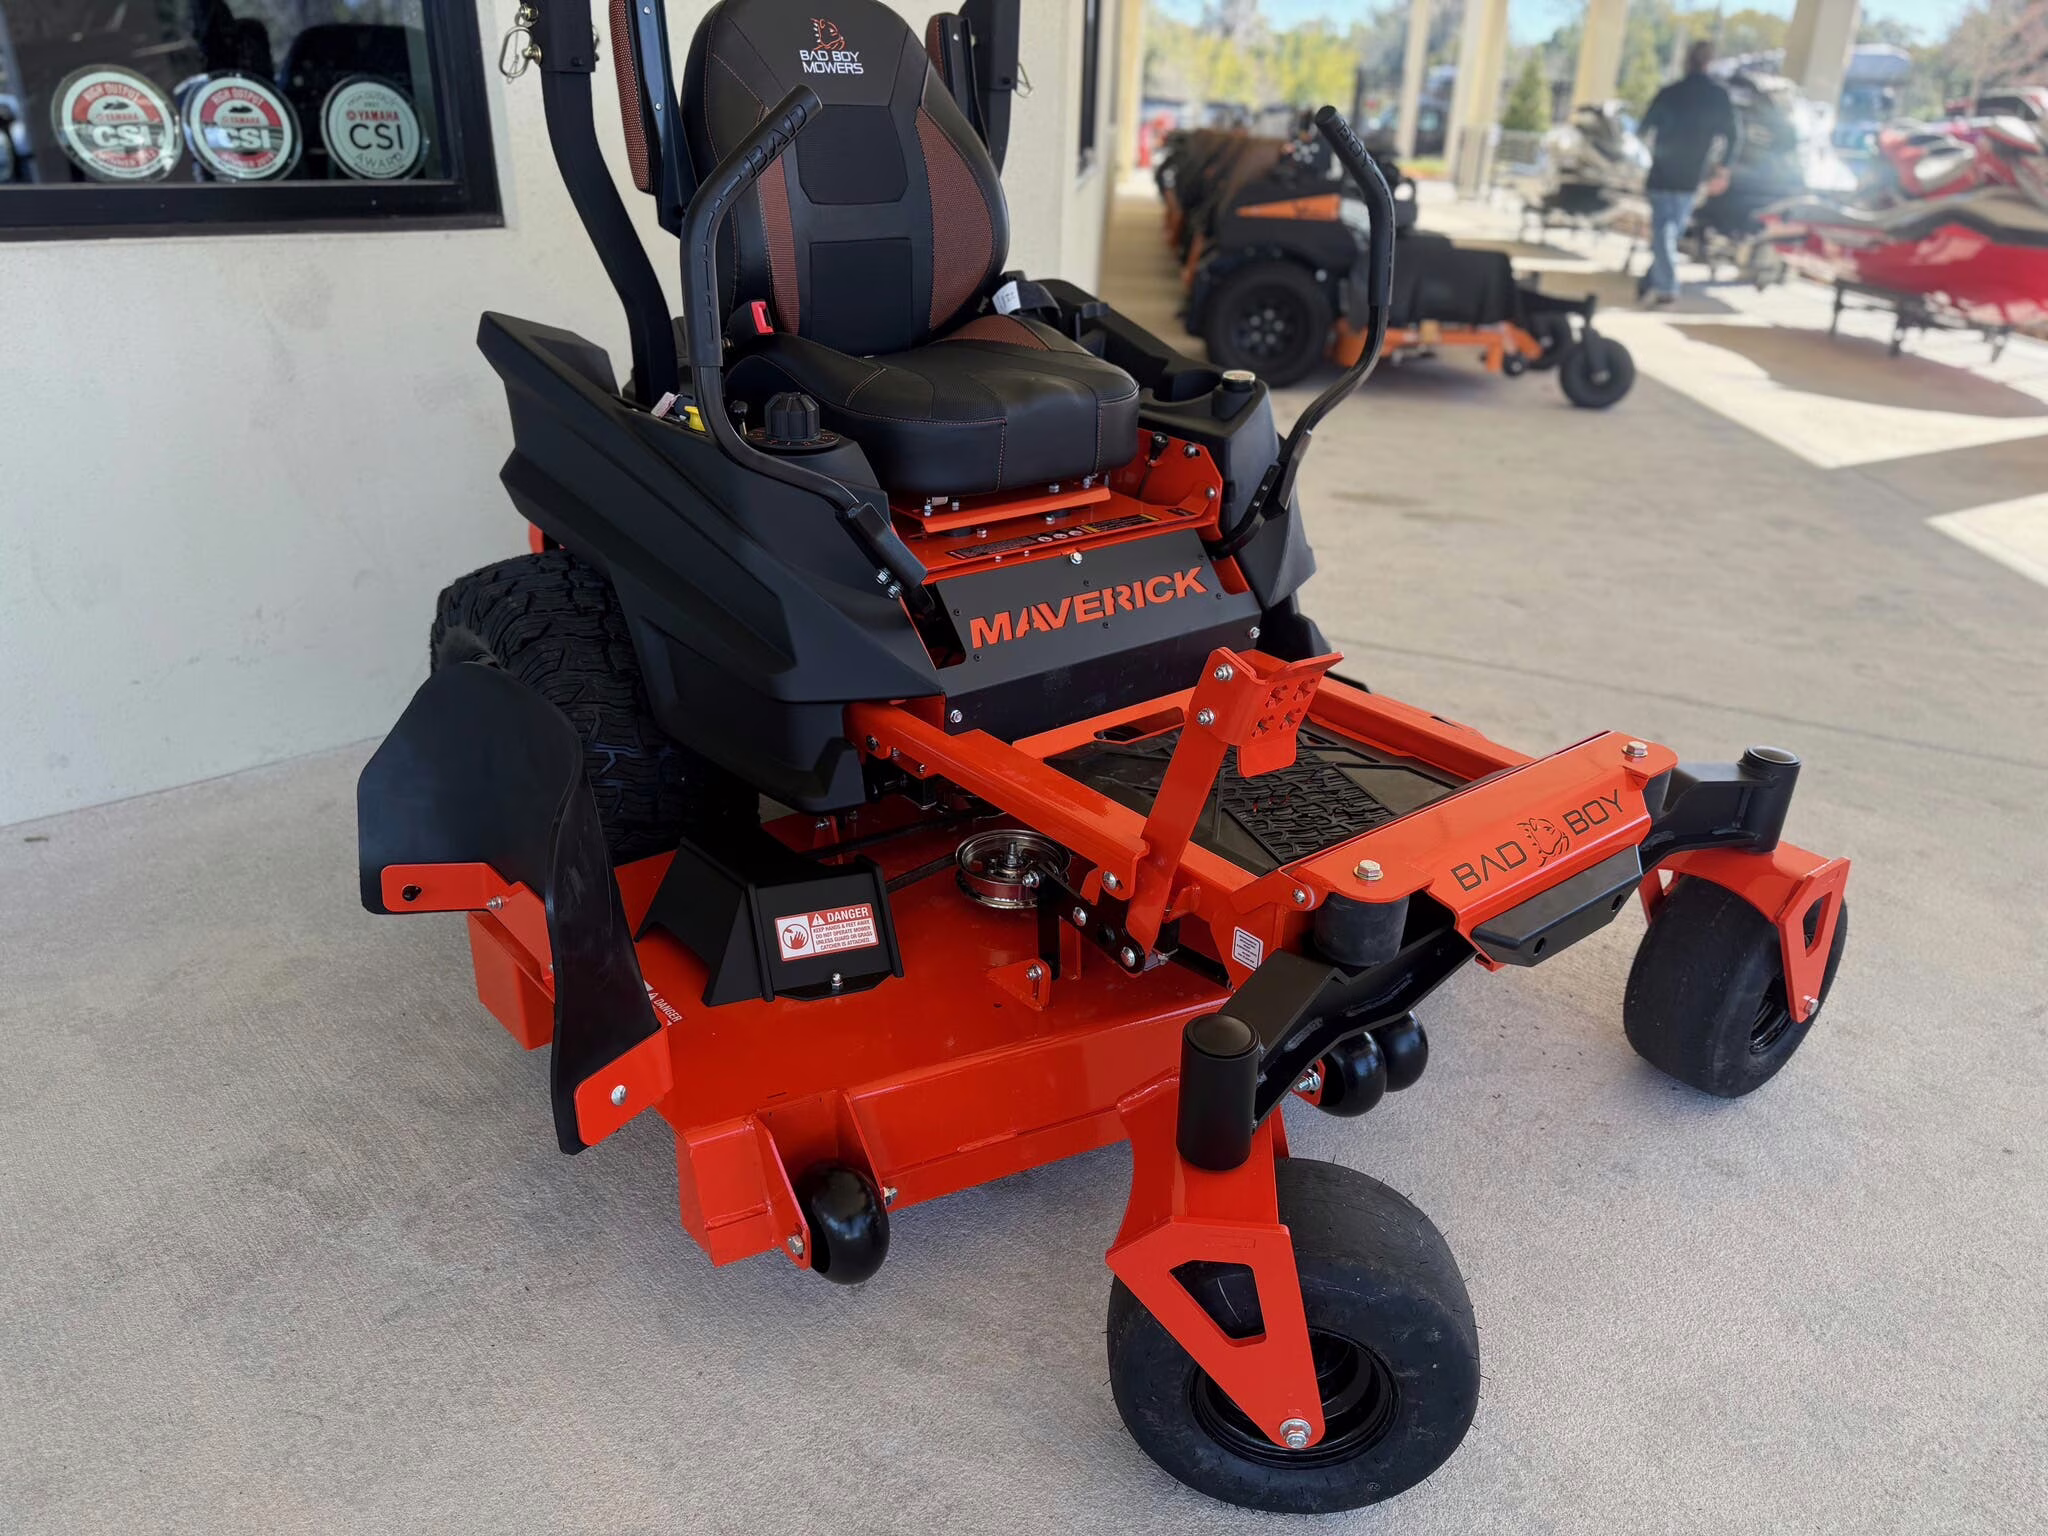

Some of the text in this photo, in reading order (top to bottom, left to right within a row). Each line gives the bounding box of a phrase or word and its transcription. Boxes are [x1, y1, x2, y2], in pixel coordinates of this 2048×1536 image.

[800, 49, 860, 62] BAD BOY
[802, 61, 864, 75] MOWERS
[232, 88, 264, 106] OUTPUT
[105, 112, 139, 120] YAMAHA
[230, 116, 260, 124] YAMAHA
[358, 111, 400, 121] YAMAHA
[92, 125, 153, 147] CSI
[218, 127, 271, 149] CSI
[349, 123, 404, 150] CSI
[355, 152, 402, 169] AWARD
[969, 566, 1209, 649] MAVERICK
[1450, 788, 1623, 892] BAD BOY
[827, 906, 869, 923] DANGER
[825, 924, 841, 932] HANDS
[820, 943, 841, 951] CATCHER
[653, 998, 683, 1023] DANGER
